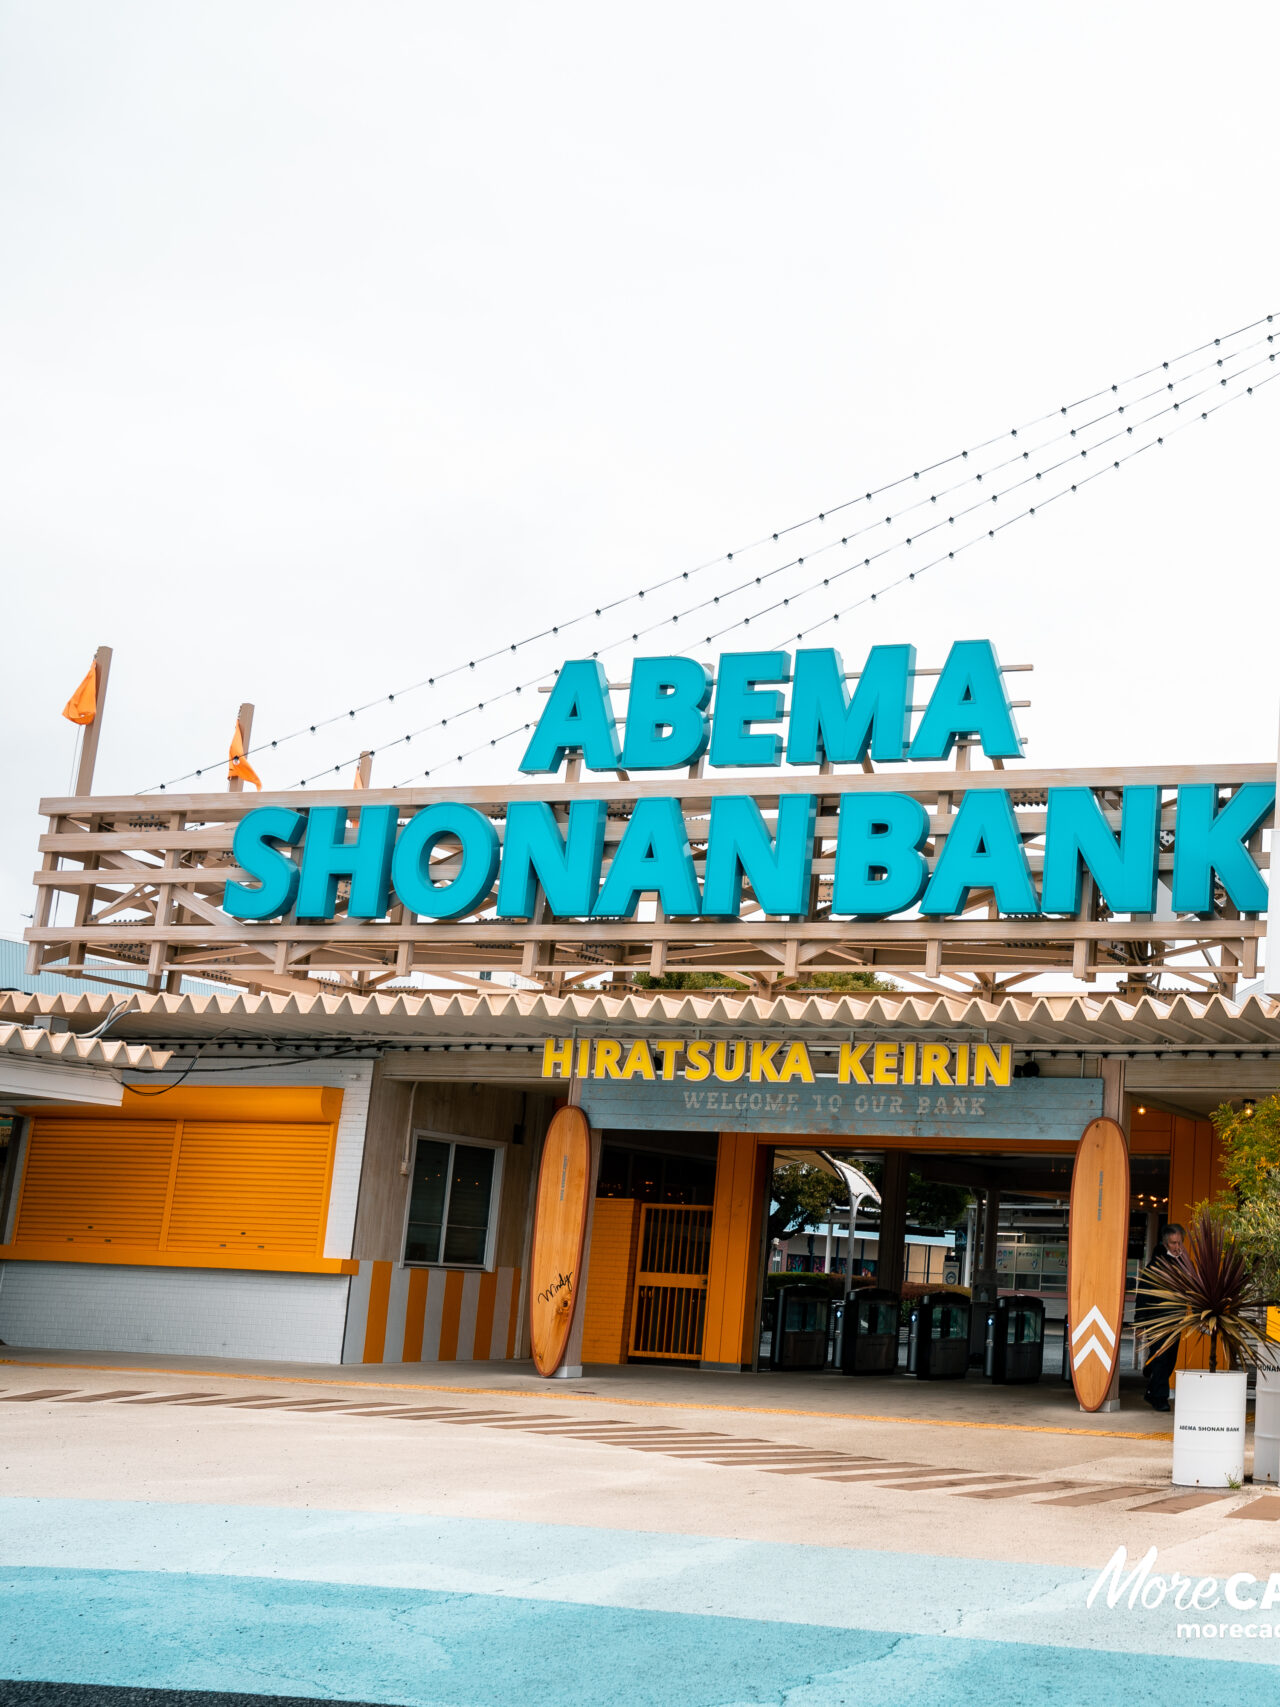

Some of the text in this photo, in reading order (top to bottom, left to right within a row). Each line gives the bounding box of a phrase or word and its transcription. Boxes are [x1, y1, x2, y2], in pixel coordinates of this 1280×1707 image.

[518, 639, 1026, 775] ABEMA
[223, 781, 1276, 922] SHONAN BANK
[541, 1038, 1014, 1087] HIRATSUKA KEIRIN
[683, 1091, 985, 1115] WELCOME TO OUR BANK
[538, 1272, 573, 1304] Windy
